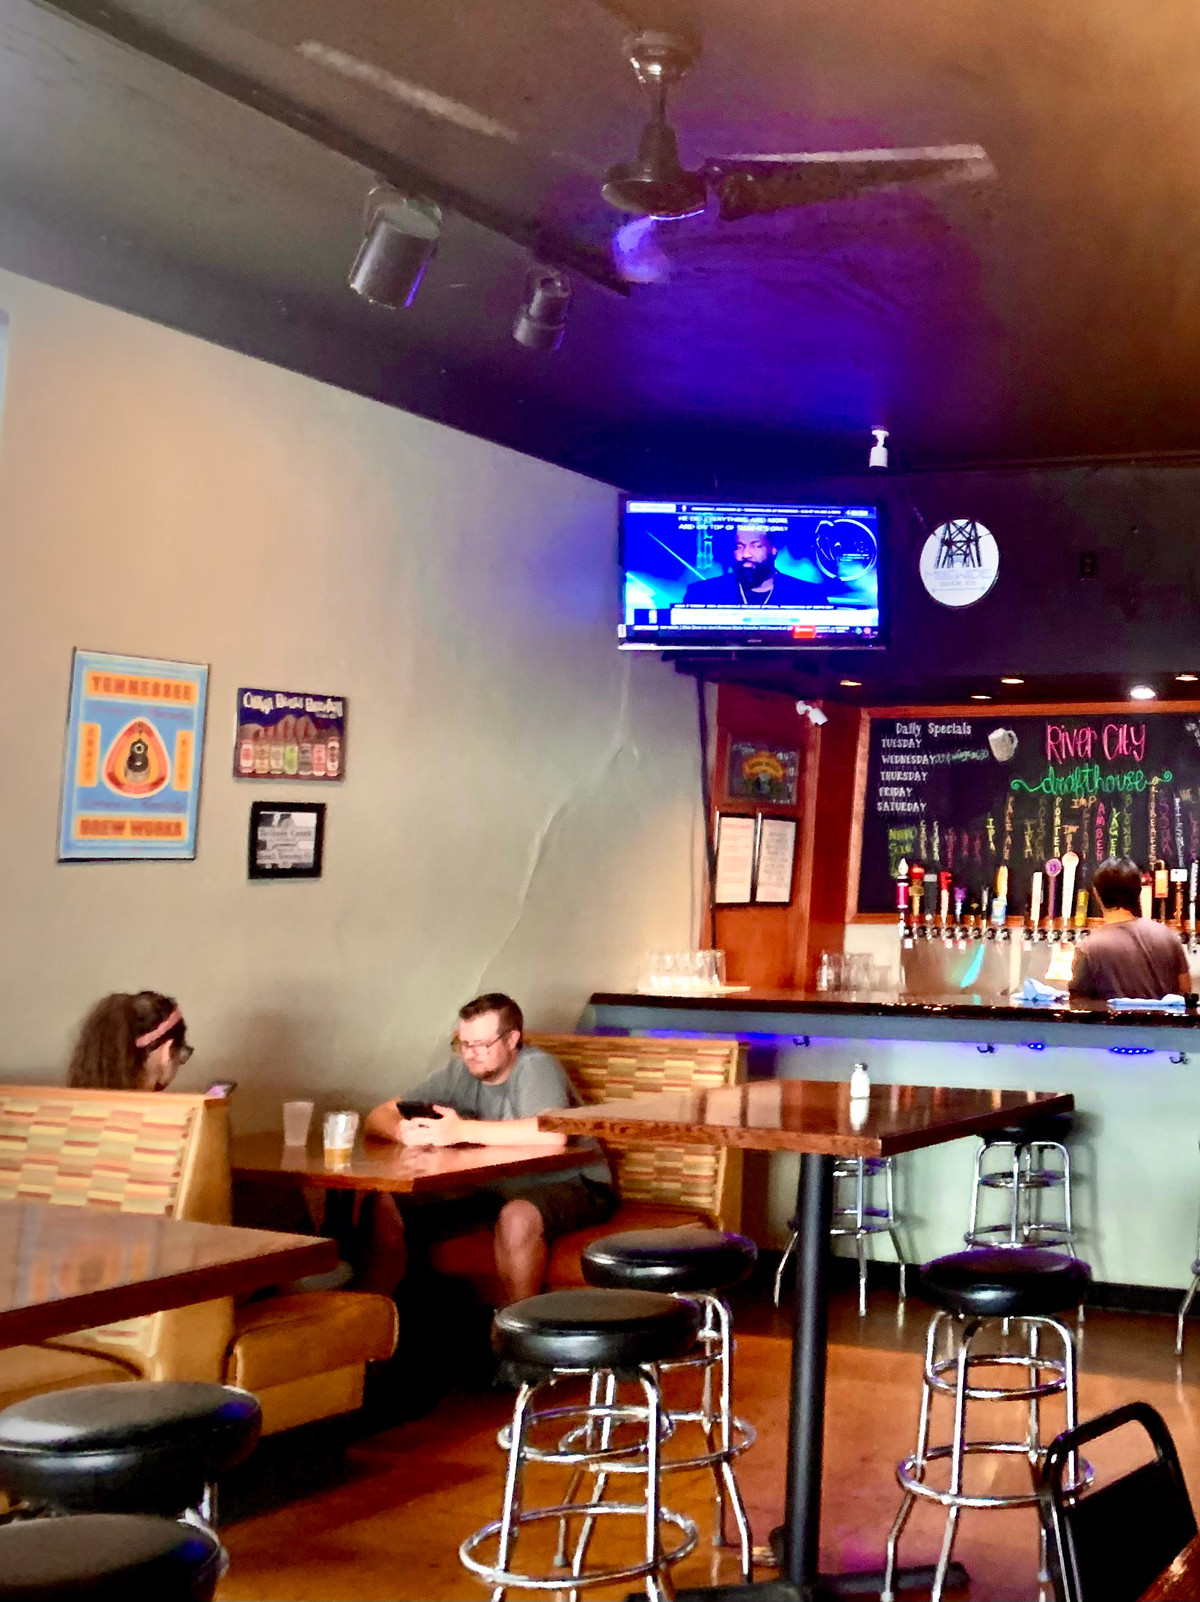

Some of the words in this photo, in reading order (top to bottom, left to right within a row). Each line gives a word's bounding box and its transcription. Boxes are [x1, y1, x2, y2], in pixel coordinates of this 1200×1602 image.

[896, 723, 922, 738] Daily
[928, 723, 972, 737] Specials
[882, 738, 922, 749] TUESDAY
[1104, 723, 1146, 761] City
[882, 754, 936, 765] WEDNESDAY
[880, 771, 928, 781] THURSDAY
[1042, 762, 1148, 795] drafthouse
[879, 787, 913, 797] FRIDAY
[877, 802, 927, 812] SATURDAY
[1053, 797, 1063, 858] PORTER
[1095, 802, 1106, 861] AMBER
